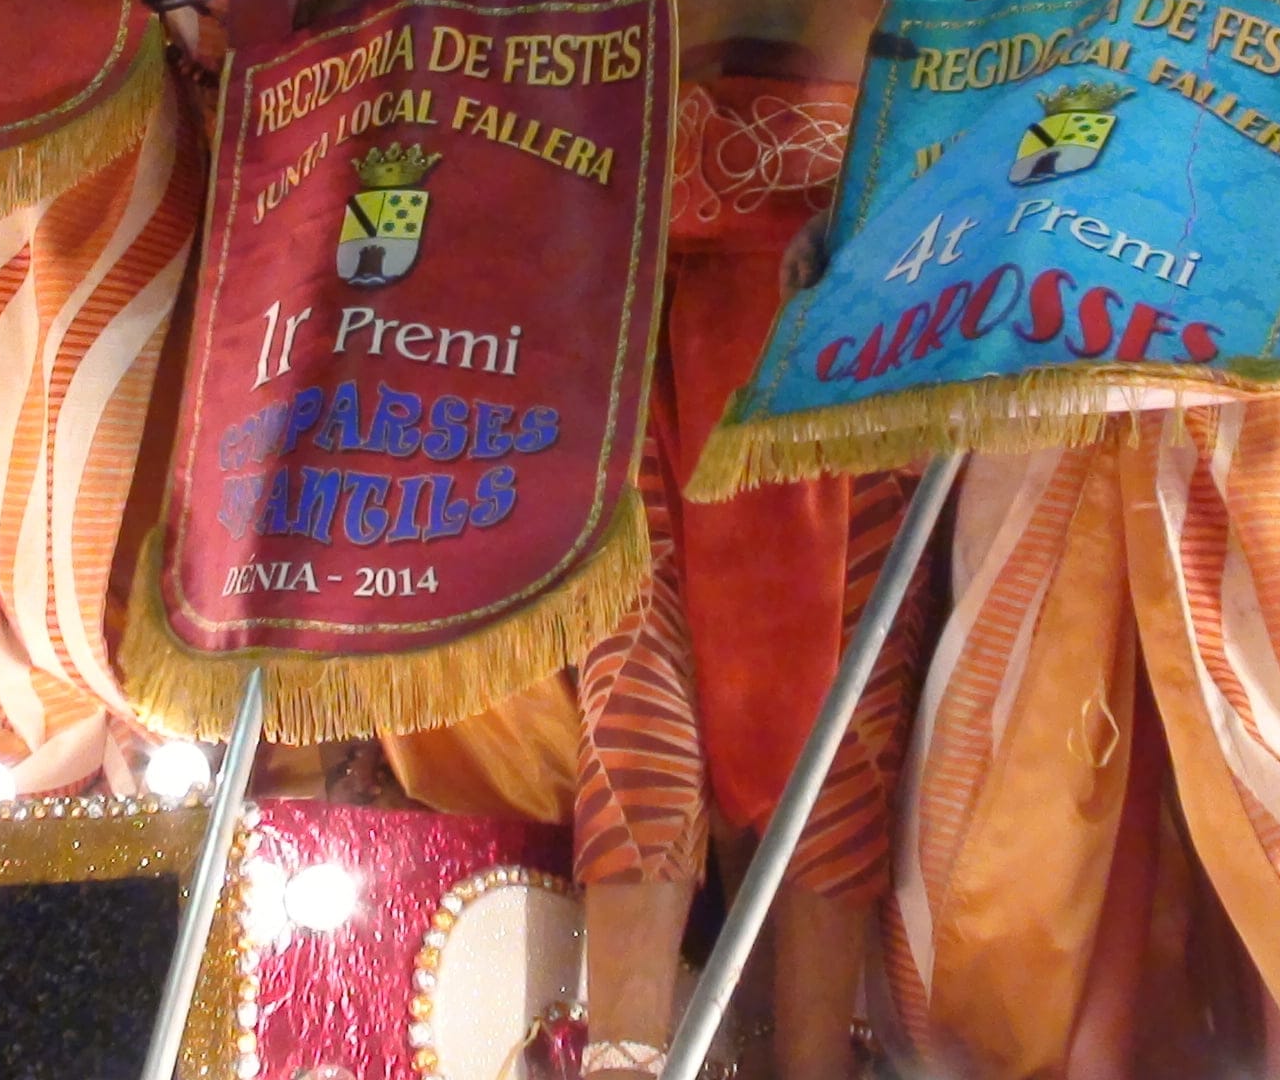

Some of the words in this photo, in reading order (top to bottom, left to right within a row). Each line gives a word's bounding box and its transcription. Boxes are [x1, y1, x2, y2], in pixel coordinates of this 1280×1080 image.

[257, 24, 414, 137] REGIDORIA
[428, 26, 492, 78] DE
[503, 26, 641, 87] FESTES
[253, 131, 328, 224] JUNTA
[335, 89, 438, 146] LOCAL
[452, 96, 615, 185] FALLERA
[1006, 198, 1202, 289] Premi
[250, 300, 312, 392] 1r
[332, 307, 522, 376] Premi
[353, 566, 439, 598] 2014
